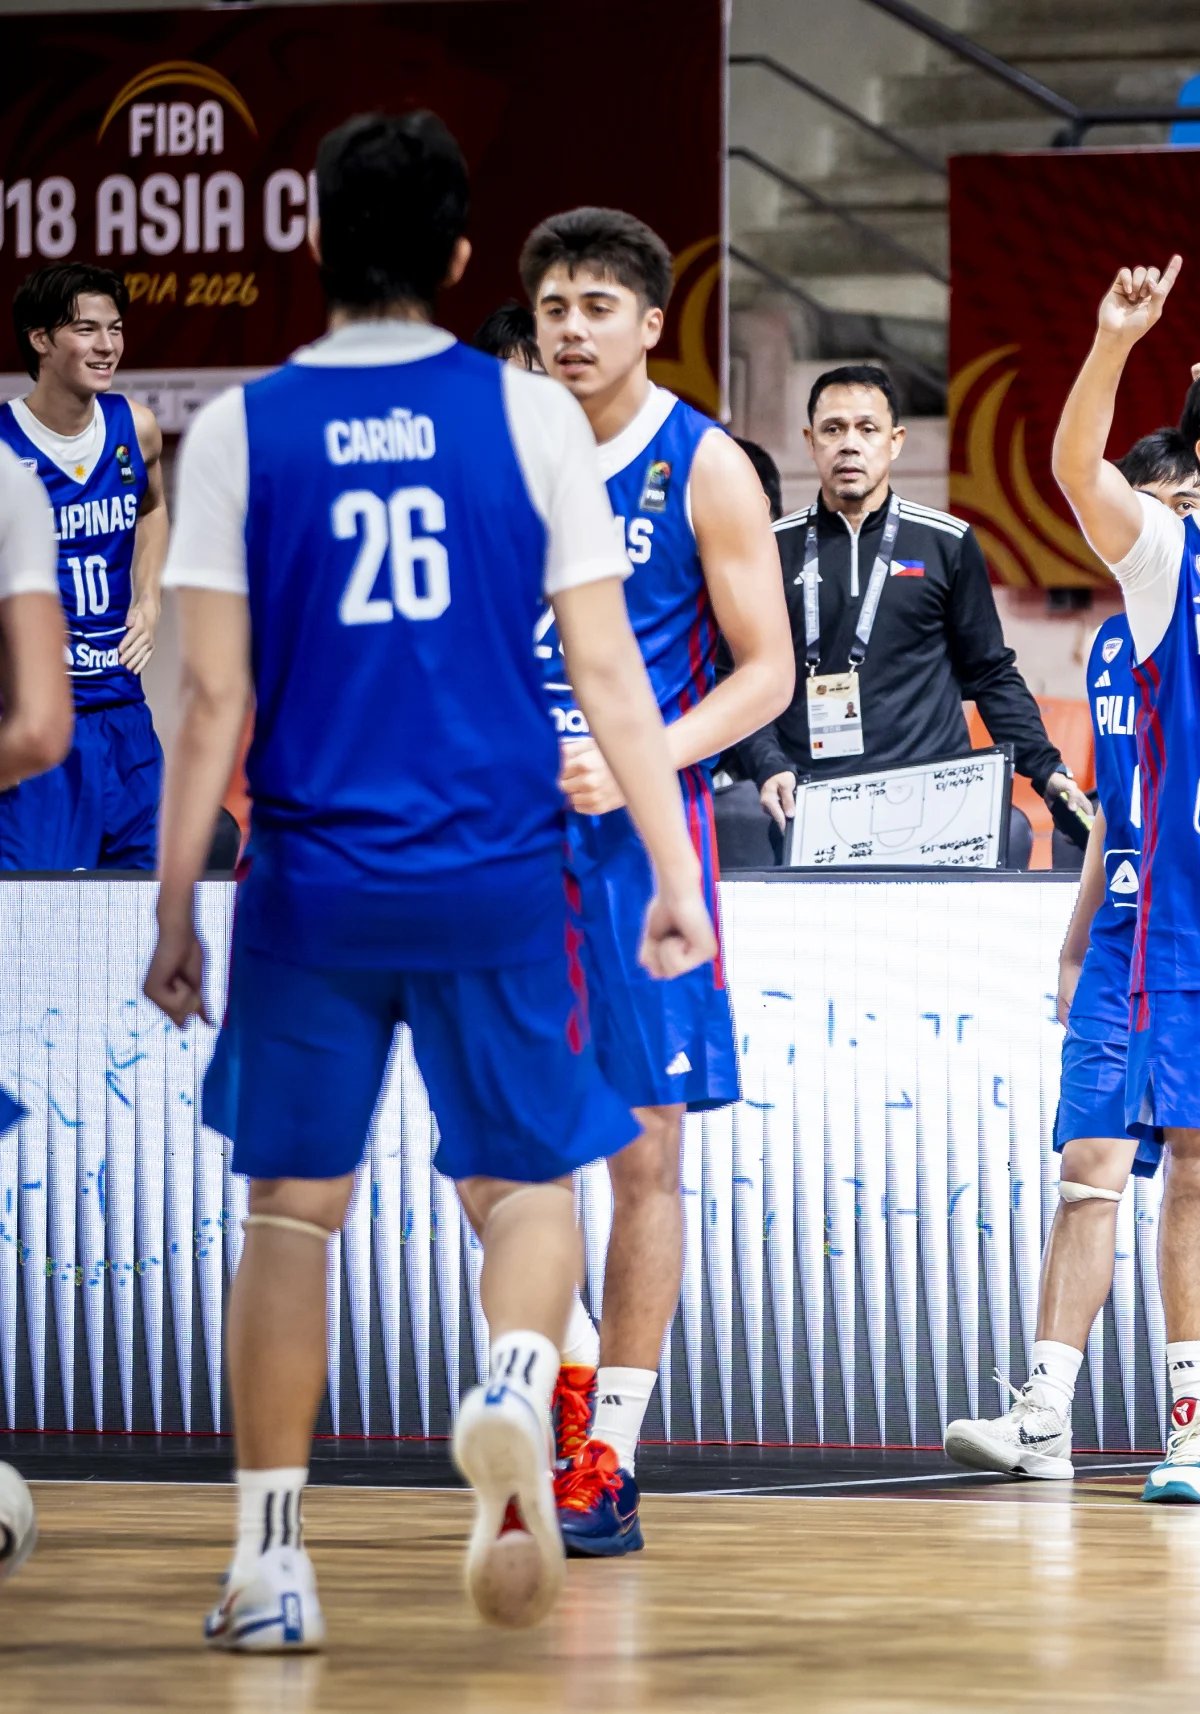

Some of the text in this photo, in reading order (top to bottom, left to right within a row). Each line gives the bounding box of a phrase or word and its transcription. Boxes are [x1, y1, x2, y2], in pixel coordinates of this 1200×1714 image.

[129, 100, 224, 158] FIBA
[0, 175, 77, 259] 18
[96, 170, 245, 256] ASIA
[124, 272, 259, 307] DIA 2026
[324, 406, 436, 466] CARIÑO
[48, 493, 137, 540] LIPINAS
[331, 485, 451, 626] 26
[67, 554, 110, 617] 10
[76, 642, 119, 668] Sma
[1096, 695, 1137, 736] PILI
